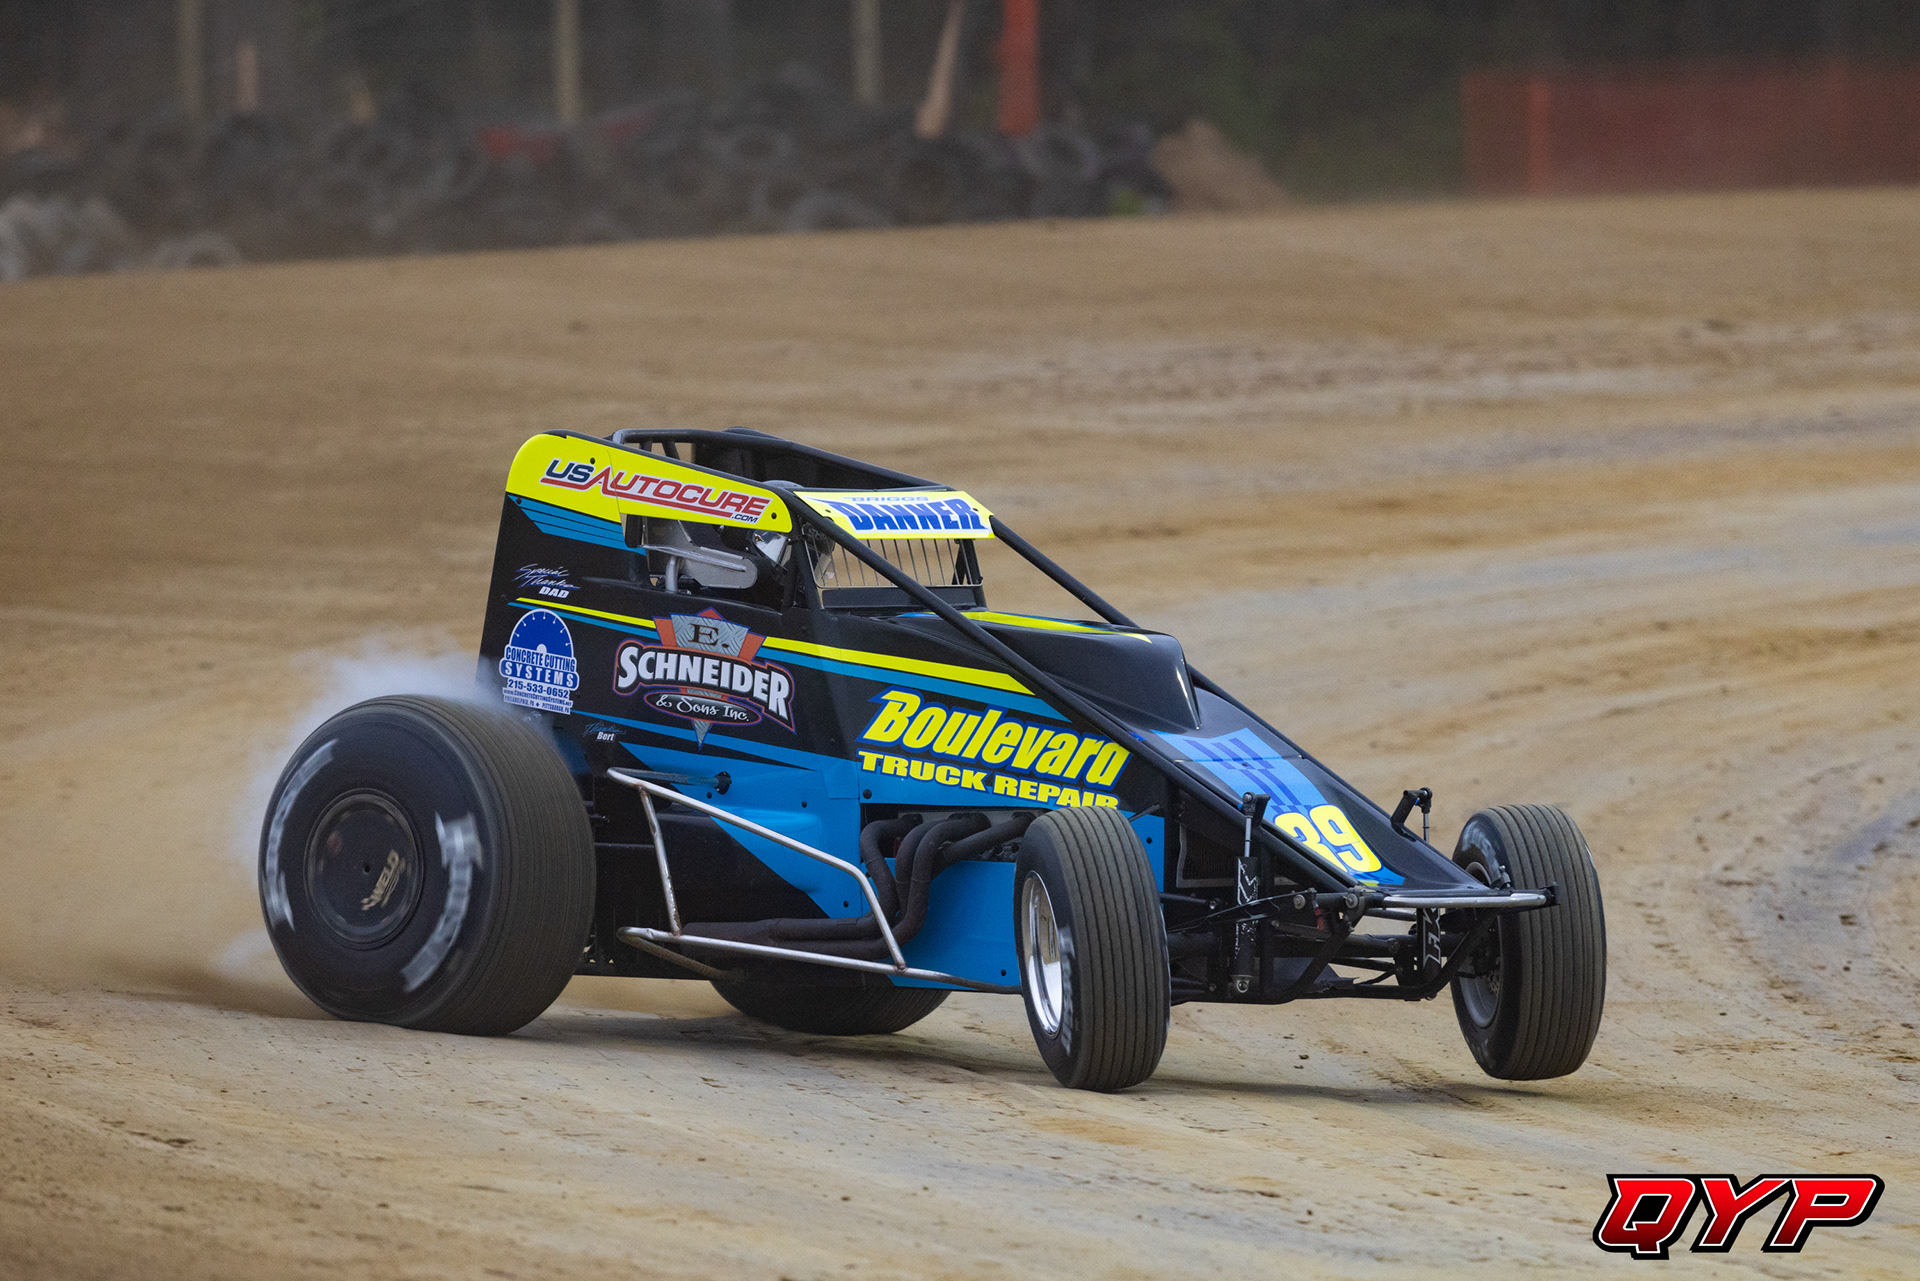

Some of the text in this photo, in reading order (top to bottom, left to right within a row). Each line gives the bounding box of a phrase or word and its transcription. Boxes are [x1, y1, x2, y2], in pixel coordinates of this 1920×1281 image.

[828, 498, 988, 531] DANNER
[538, 586, 570, 598] DAD
[688, 623, 731, 649] E.
[505, 646, 576, 673] CONCRETE CUTTING
[504, 662, 574, 687] SYSTEMS
[617, 646, 790, 721] SCHNEIDER
[508, 678, 569, 699] 215-533-0652
[655, 695, 750, 722] & Sons Inc.
[596, 731, 616, 741] Bert
[862, 690, 1131, 787] Boulevard
[858, 750, 1119, 810] TRUCK REPAIR
[1274, 804, 1382, 873] 39
